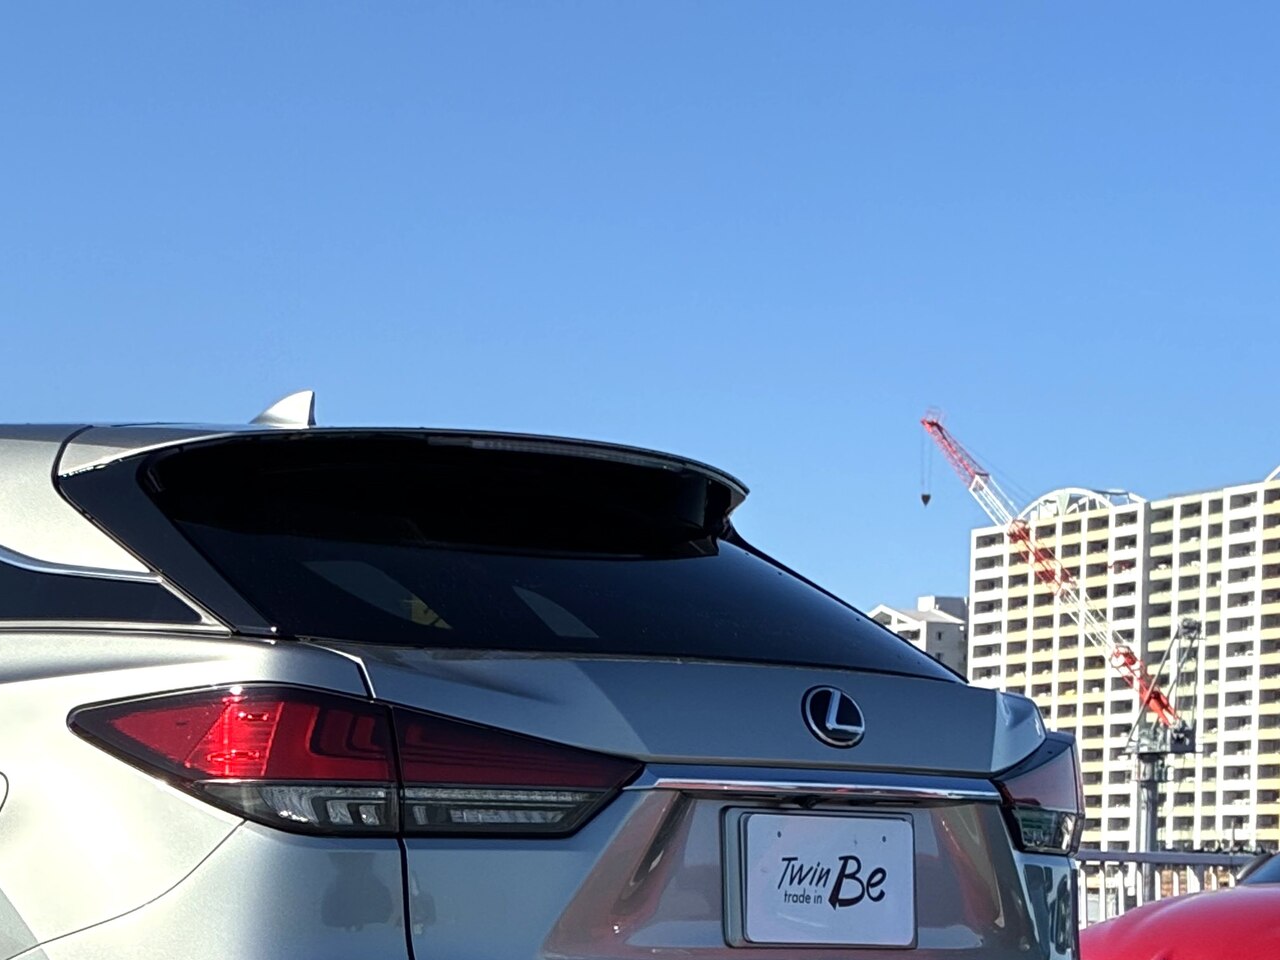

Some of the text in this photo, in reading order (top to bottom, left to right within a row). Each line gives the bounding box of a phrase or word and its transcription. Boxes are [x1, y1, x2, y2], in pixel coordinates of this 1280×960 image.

[778, 855, 887, 910] Twin Be
[784, 888, 822, 904] trade in
